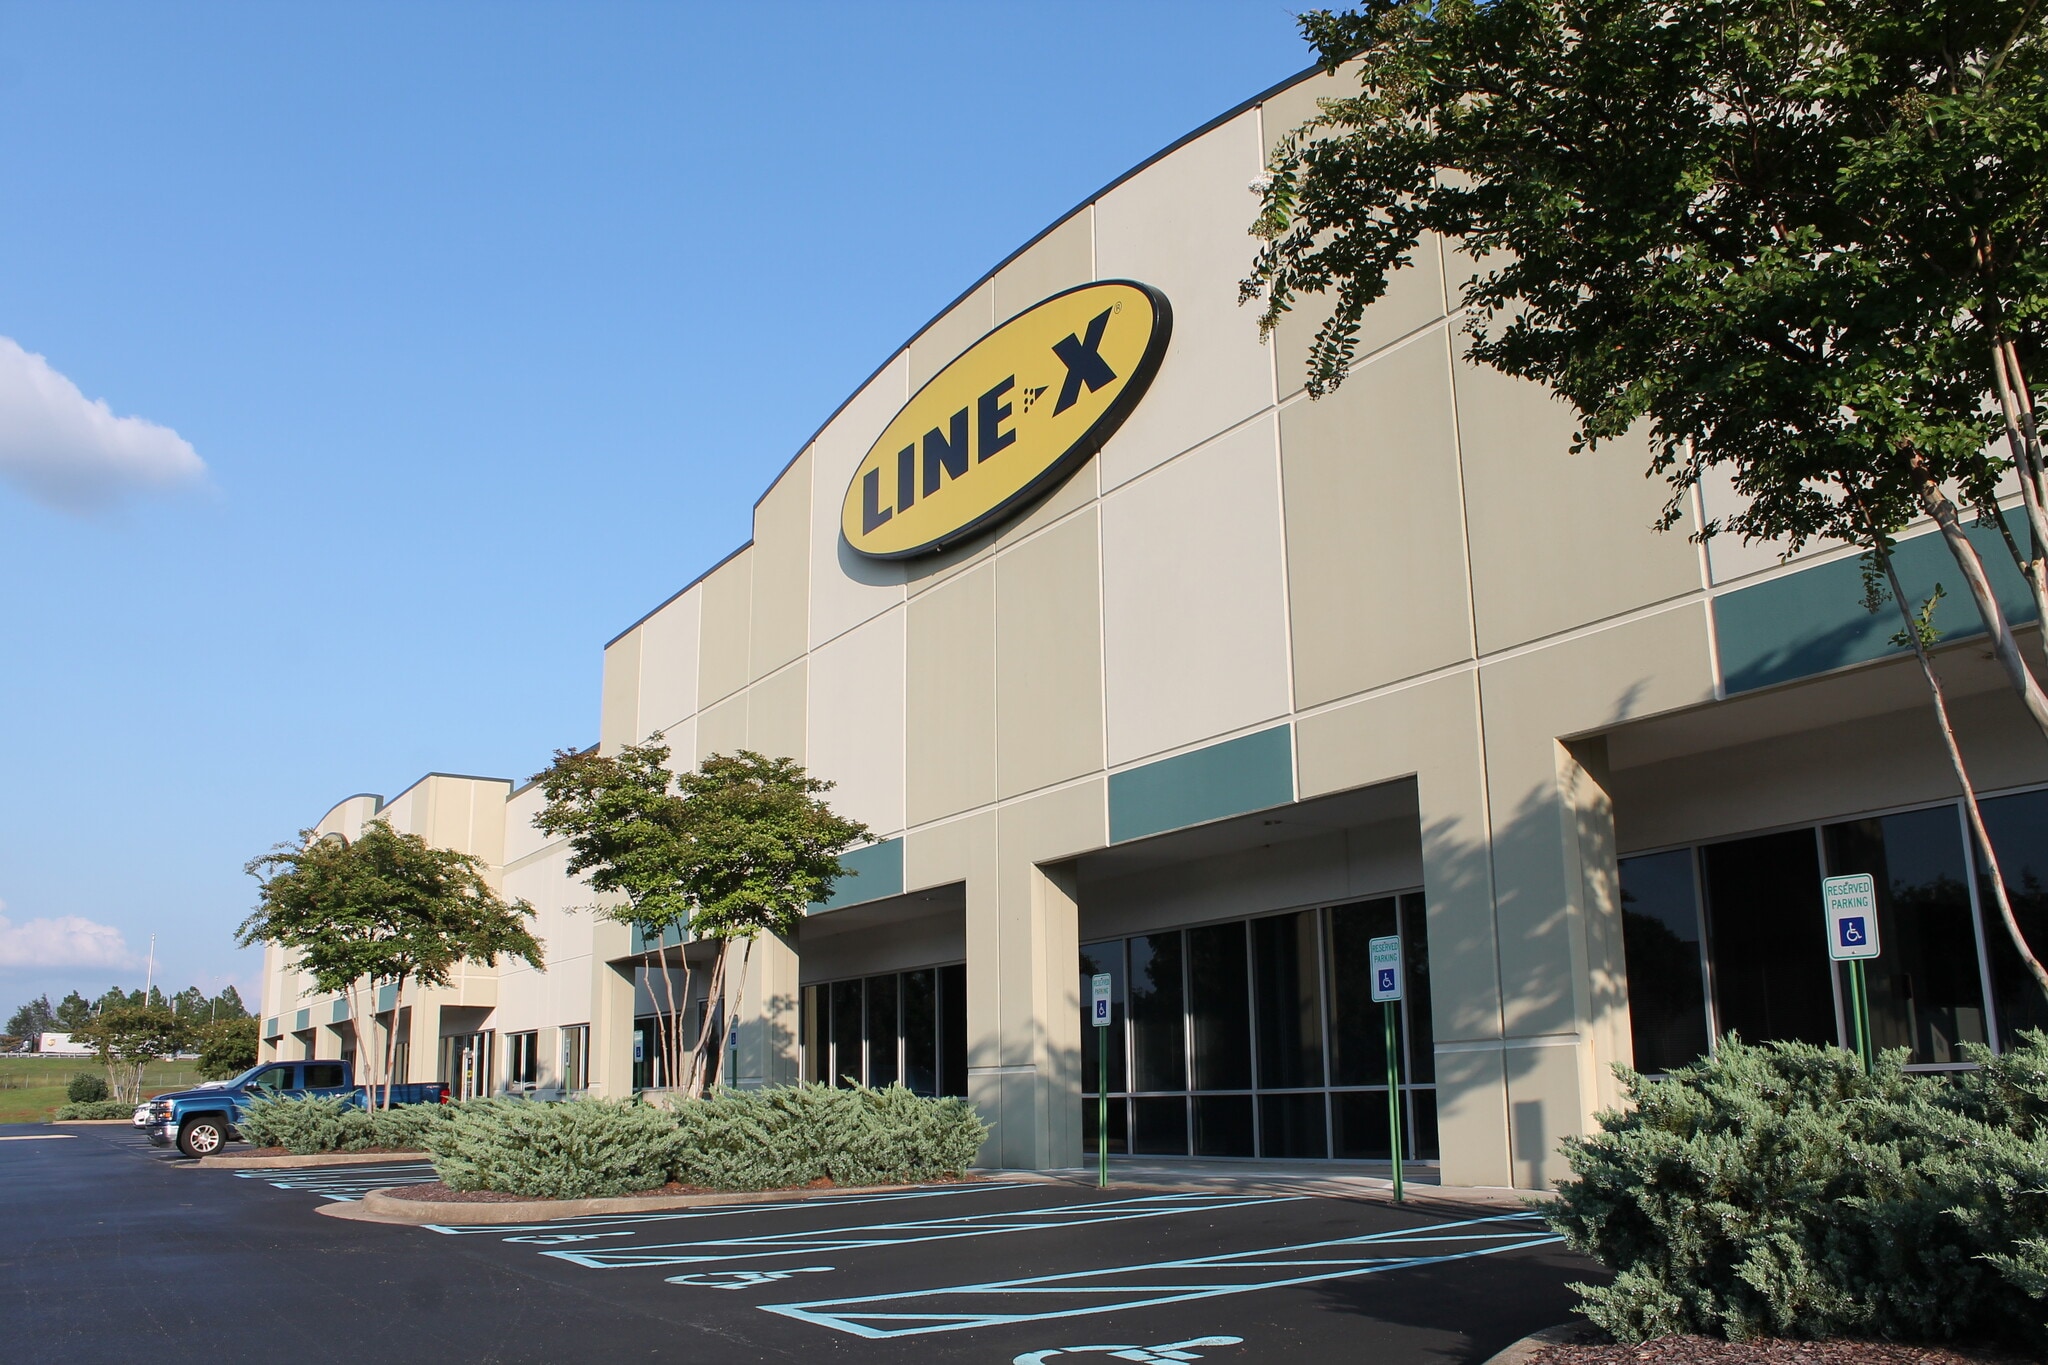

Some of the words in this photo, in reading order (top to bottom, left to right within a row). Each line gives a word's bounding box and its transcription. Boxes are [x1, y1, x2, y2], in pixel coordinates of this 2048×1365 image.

[1827, 882, 1870, 896] RESERVED
[1831, 896, 1869, 909] PARKING
[1372, 943, 1398, 953] RESERVED
[1374, 953, 1397, 963] PARKING
